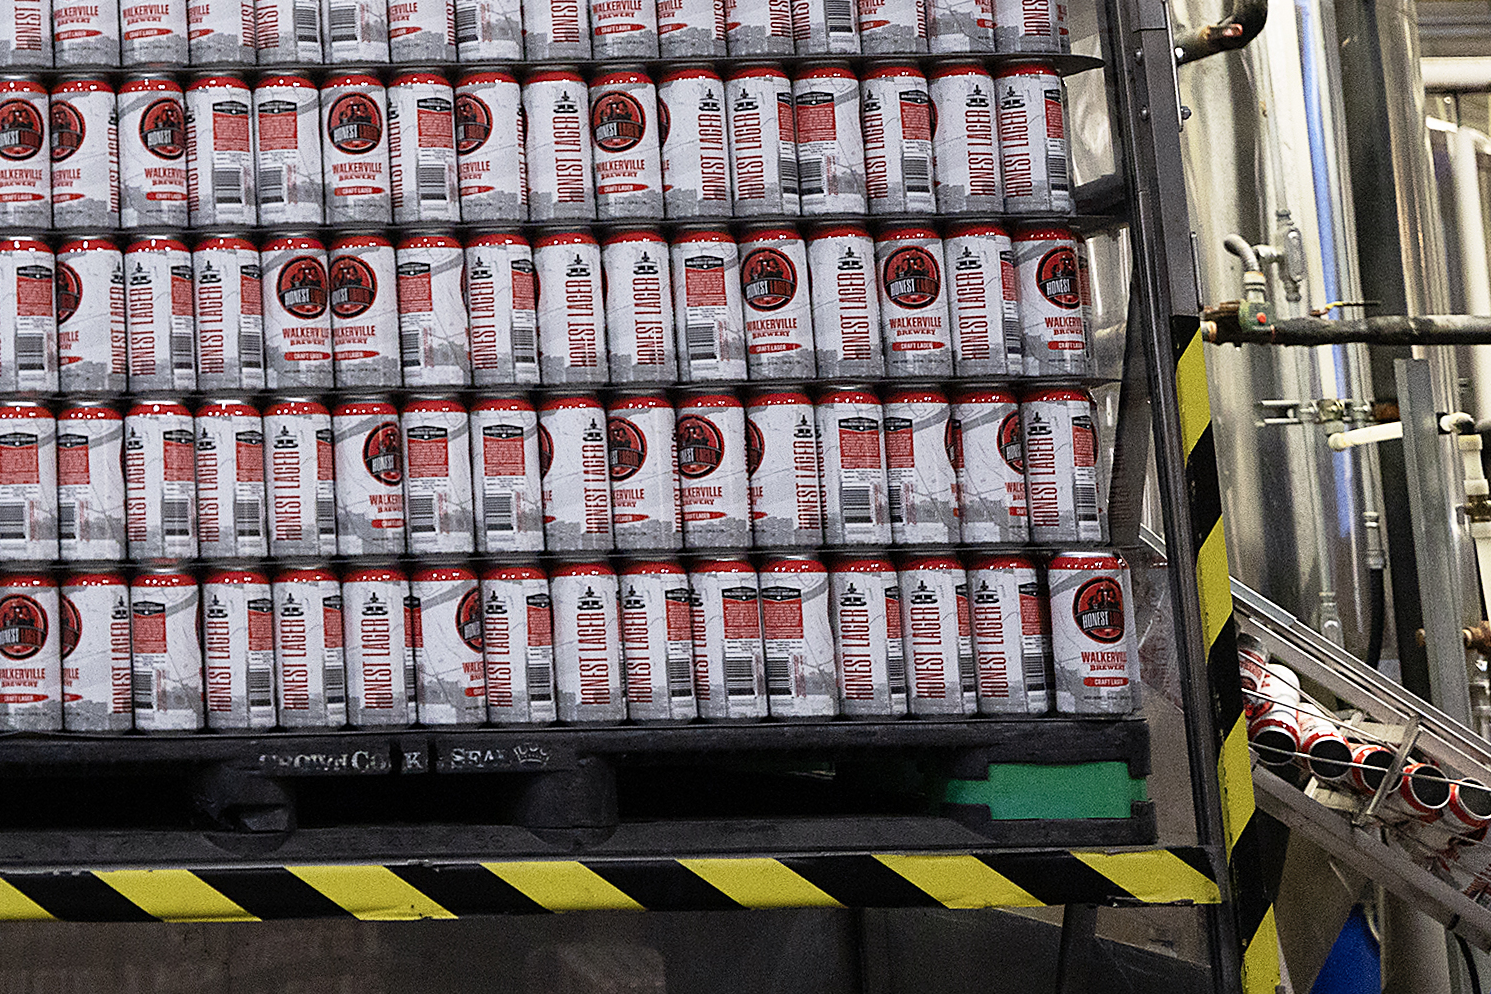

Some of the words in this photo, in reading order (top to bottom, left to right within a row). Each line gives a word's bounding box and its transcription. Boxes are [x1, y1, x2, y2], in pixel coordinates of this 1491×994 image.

[14, 7, 41, 50] HONEST
[550, 0, 579, 42] HONEST
[553, 116, 581, 153] LAGER
[698, 114, 723, 152] LAGER
[734, 112, 762, 150] LAGER
[966, 110, 993, 148] LAGER
[1001, 110, 1029, 148] LAGER
[332, 163, 382, 174] WALKERVILLE
[339, 173, 376, 181] BREWERY
[555, 158, 584, 202] HONEST
[700, 155, 726, 200] HONEST
[736, 154, 765, 200] HONEST
[968, 151, 996, 196] HONEST
[1004, 152, 1032, 197] HONEST
[199, 286, 223, 324] LAGER
[470, 282, 496, 320] LAGER
[565, 280, 594, 318] LAGER
[633, 278, 662, 316] LAGER
[837, 272, 868, 310] LAGER
[891, 281, 914, 296] HONEST
[956, 272, 986, 310] LAGER
[1047, 281, 1070, 296] HONEST
[636, 320, 664, 365] HONEST
[747, 318, 797, 331] WALKERVILLE
[753, 330, 790, 338] BREWERY
[839, 315, 871, 360] HONEST
[889, 317, 941, 329] WALKERVILLE
[958, 314, 989, 360] HONEST
[200, 328, 223, 374] HONEST
[472, 323, 497, 369] HONEST
[568, 322, 596, 367] HONEST
[273, 451, 300, 490] LAGER
[583, 444, 606, 484] LAGER
[1027, 438, 1055, 476] LAGER
[274, 494, 302, 540] HONEST
[584, 486, 608, 533] HONEST
[1030, 480, 1059, 527] HONEST
[281, 619, 307, 658] LAGER
[361, 618, 390, 657] LAGER
[577, 613, 607, 652] LAGER
[841, 609, 869, 648] LAGER
[911, 607, 942, 647] LAGER
[975, 606, 1004, 646] LAGER
[1082, 611, 1108, 629] HONEST
[282, 663, 309, 710] HONEST
[363, 662, 393, 709] HONEST
[579, 657, 610, 704] HONEST
[843, 653, 874, 700] HONEST
[913, 651, 945, 699] HONEST
[977, 650, 1008, 698] HONEST
